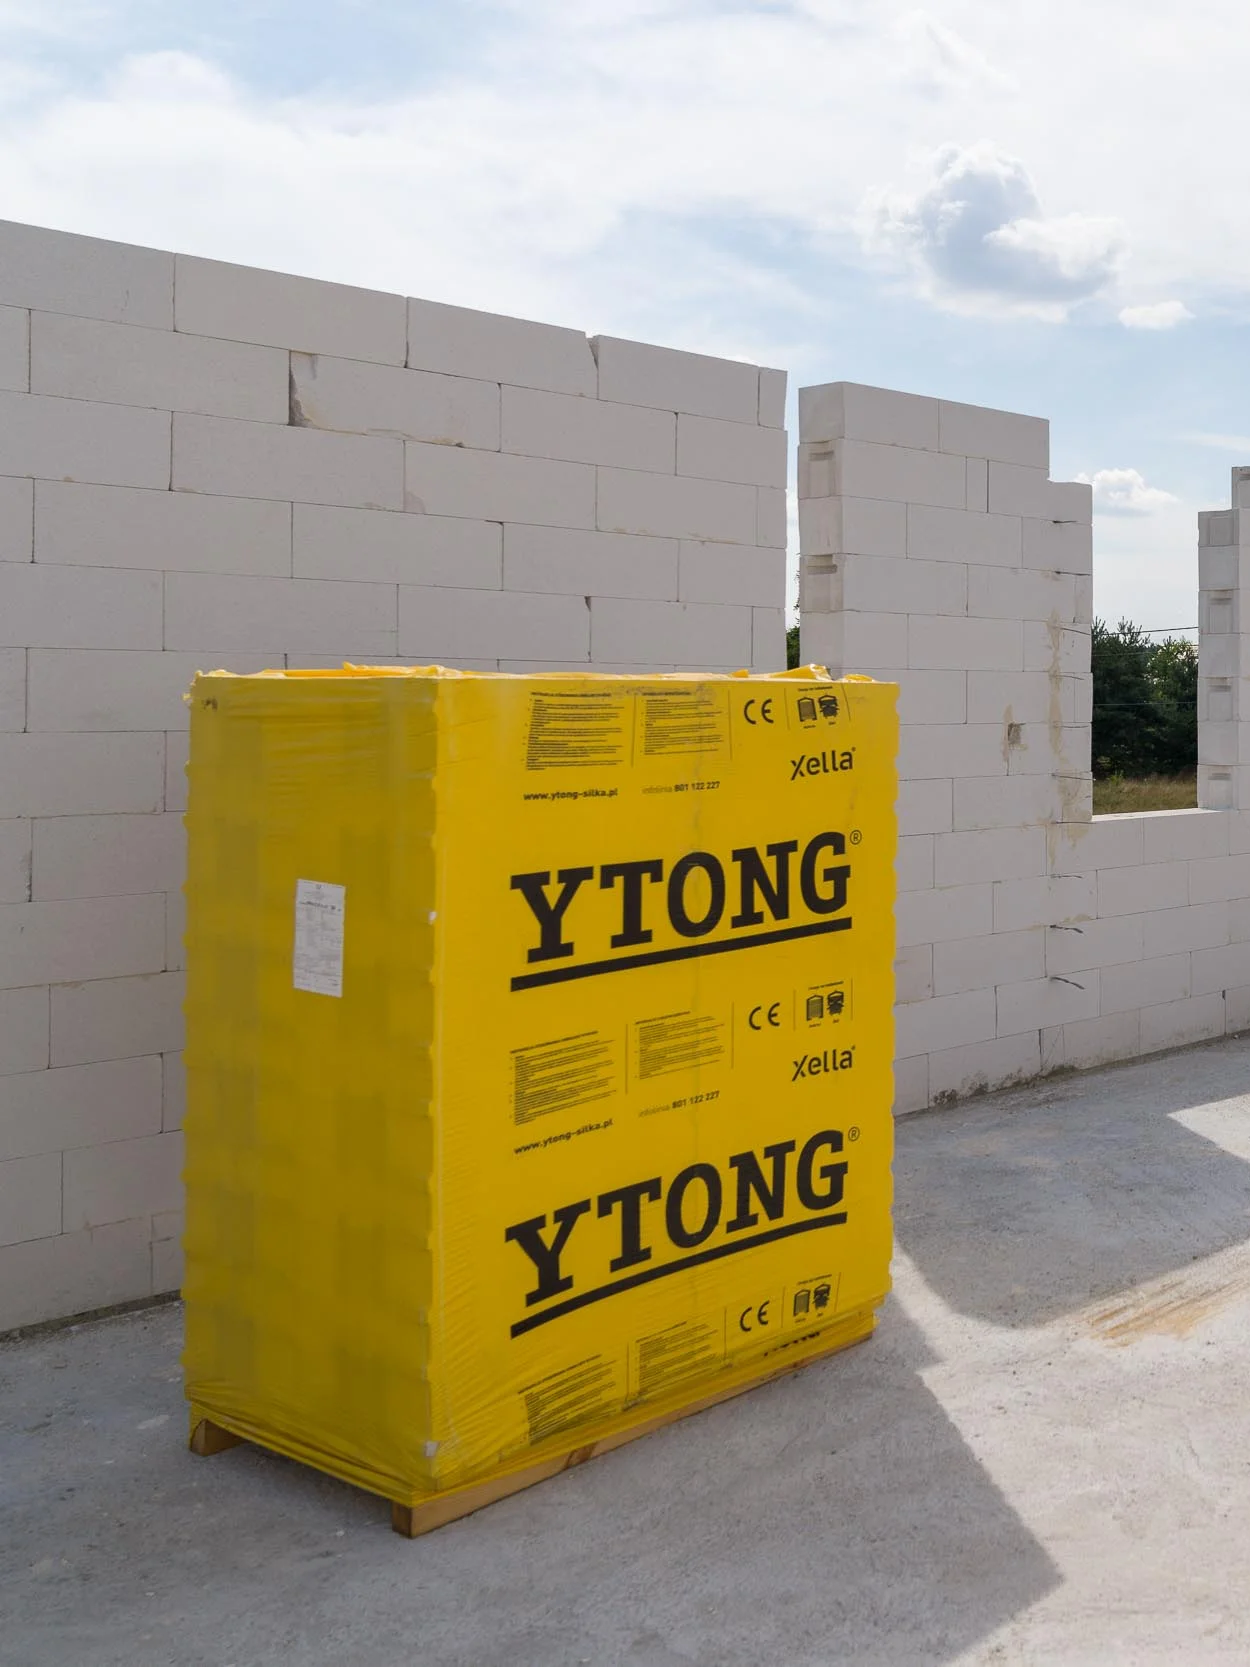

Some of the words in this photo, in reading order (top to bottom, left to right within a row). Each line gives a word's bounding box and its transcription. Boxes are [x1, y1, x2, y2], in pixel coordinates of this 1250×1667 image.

[523, 787, 618, 802] www.ytong-silka.pl
[674, 783, 689, 793] 801
[691, 782, 705, 791] 122
[706, 780, 721, 790] 227
[510, 831, 852, 965] YTONG
[672, 1098, 687, 1110] 801
[689, 1094, 705, 1105] 122
[705, 1089, 720, 1102] 227
[513, 1117, 614, 1155] www.ytong-silka.pl
[505, 1129, 849, 1308] YTONG
